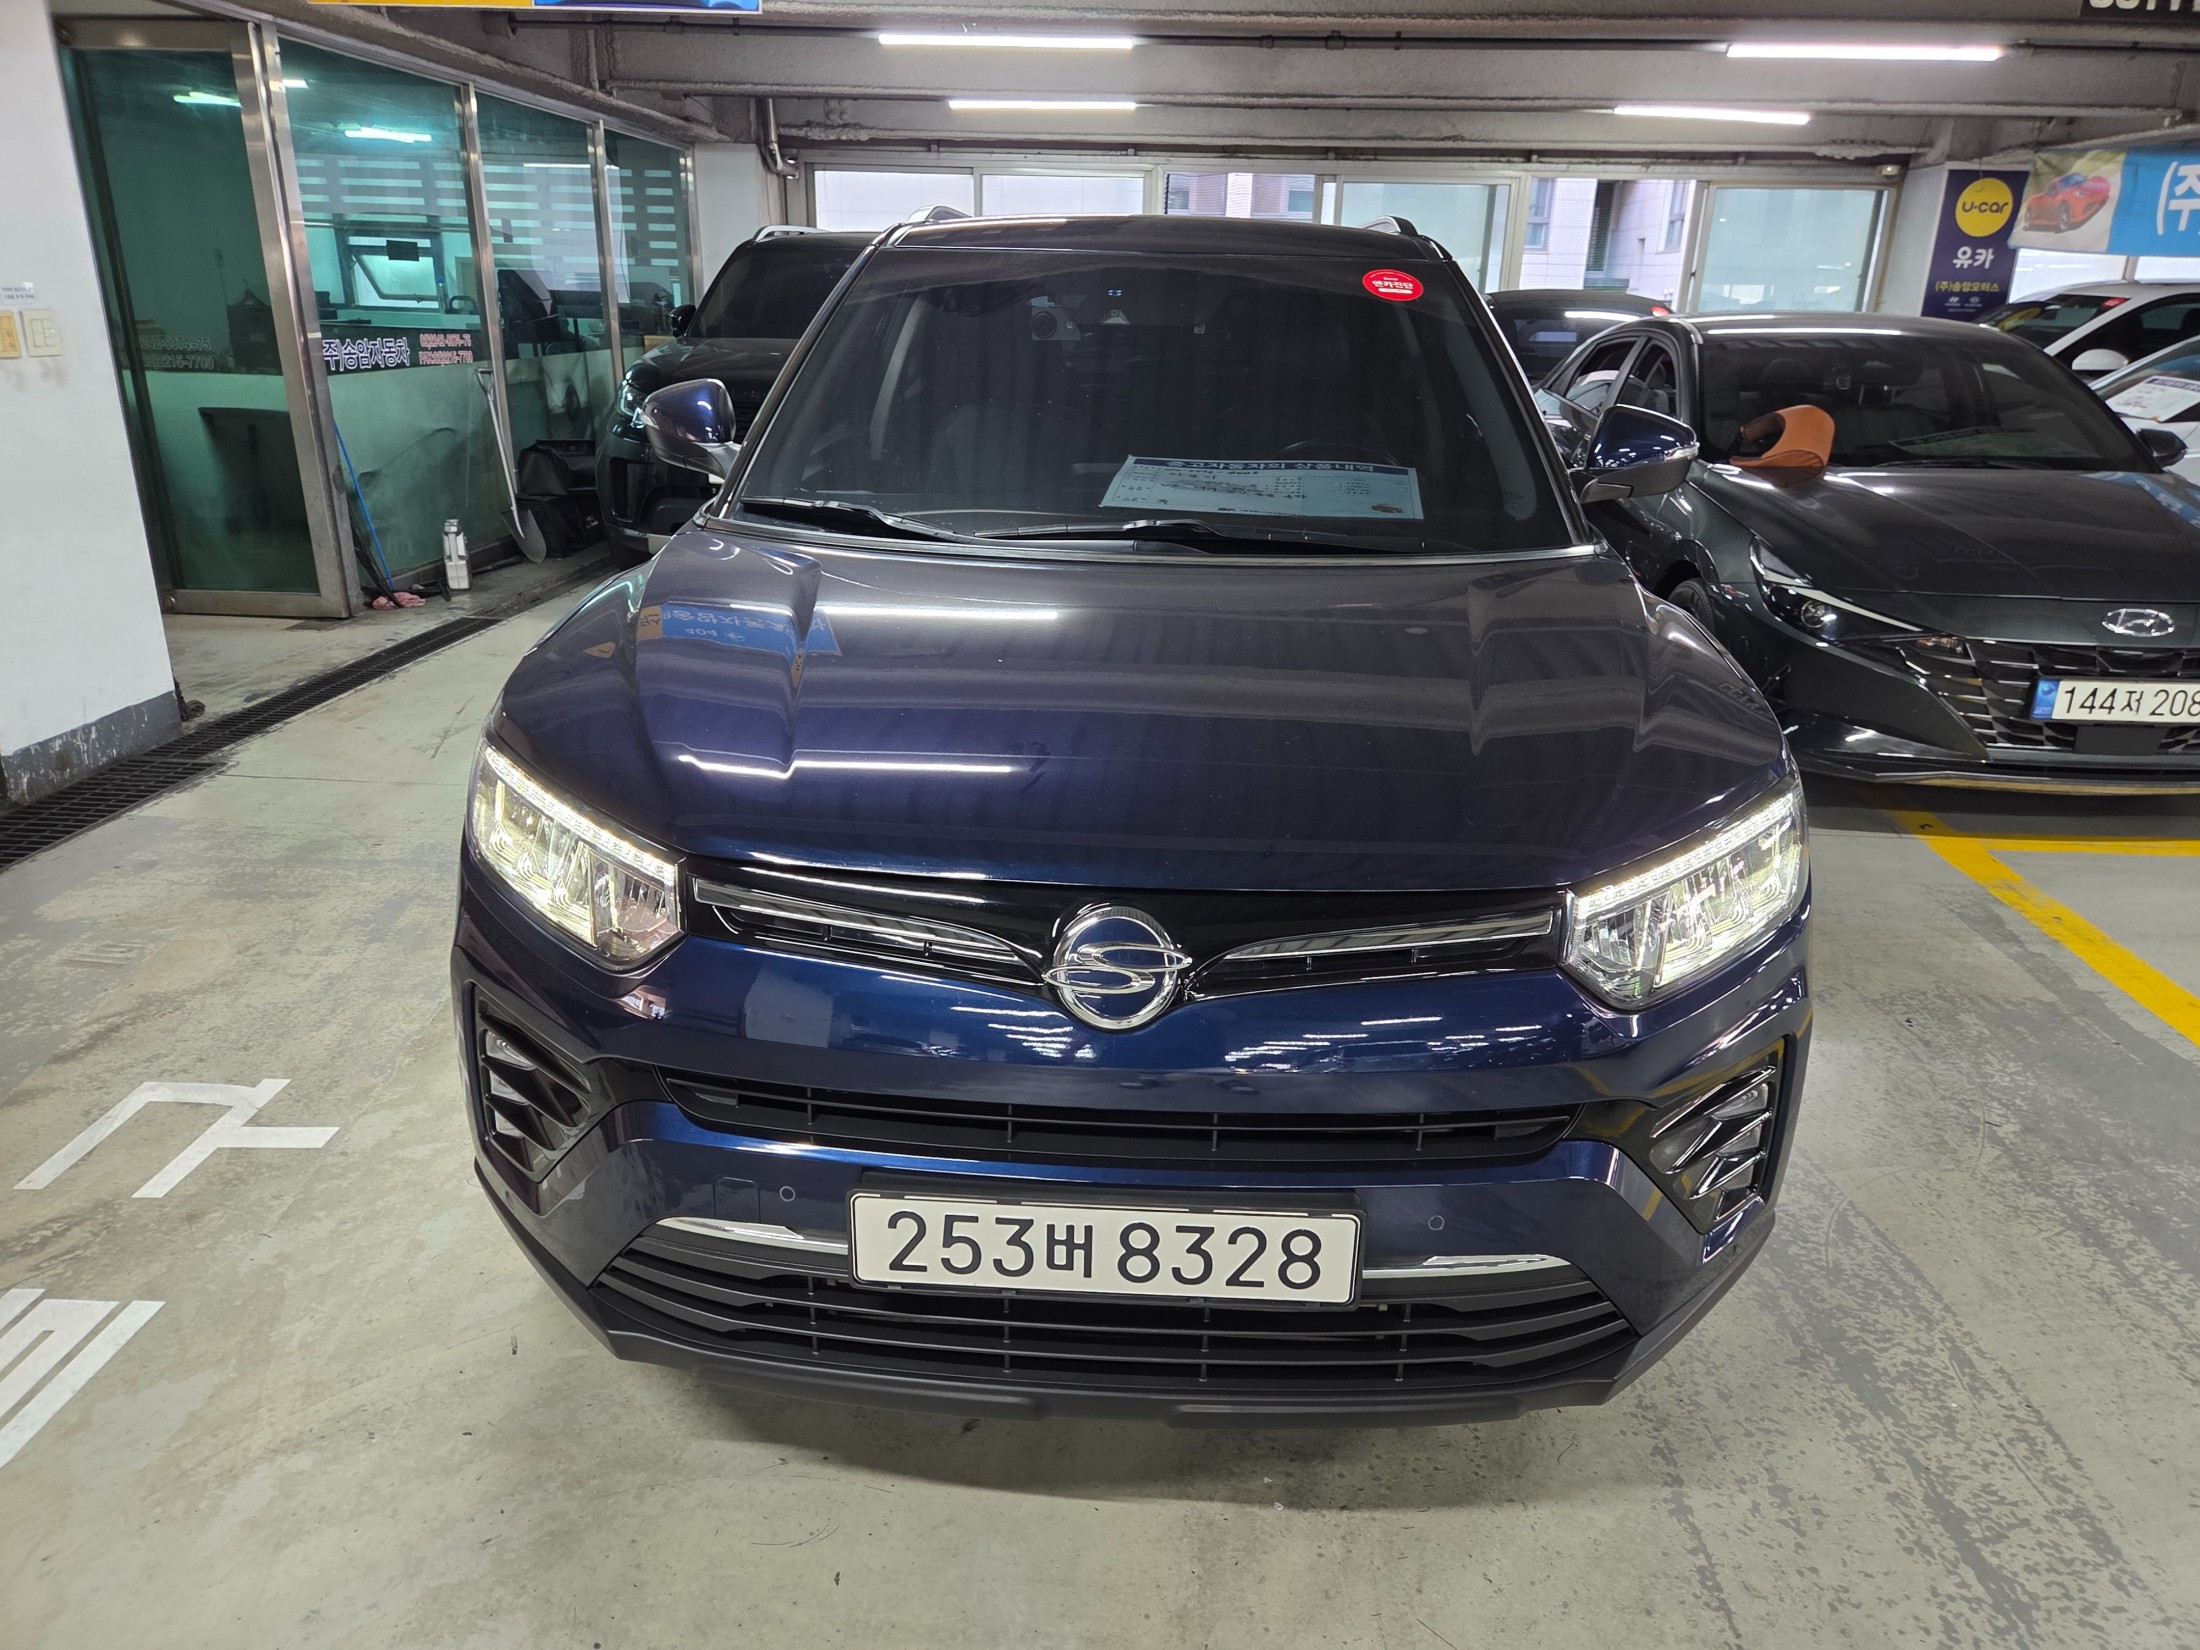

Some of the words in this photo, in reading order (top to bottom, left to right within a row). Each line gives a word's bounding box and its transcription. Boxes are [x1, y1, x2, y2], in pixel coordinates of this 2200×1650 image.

[1952, 246, 1995, 270] 유카
[2064, 686, 2144, 715] 144저
[887, 1210, 1094, 1279] 253버
[1116, 1221, 1323, 1290] 8328
